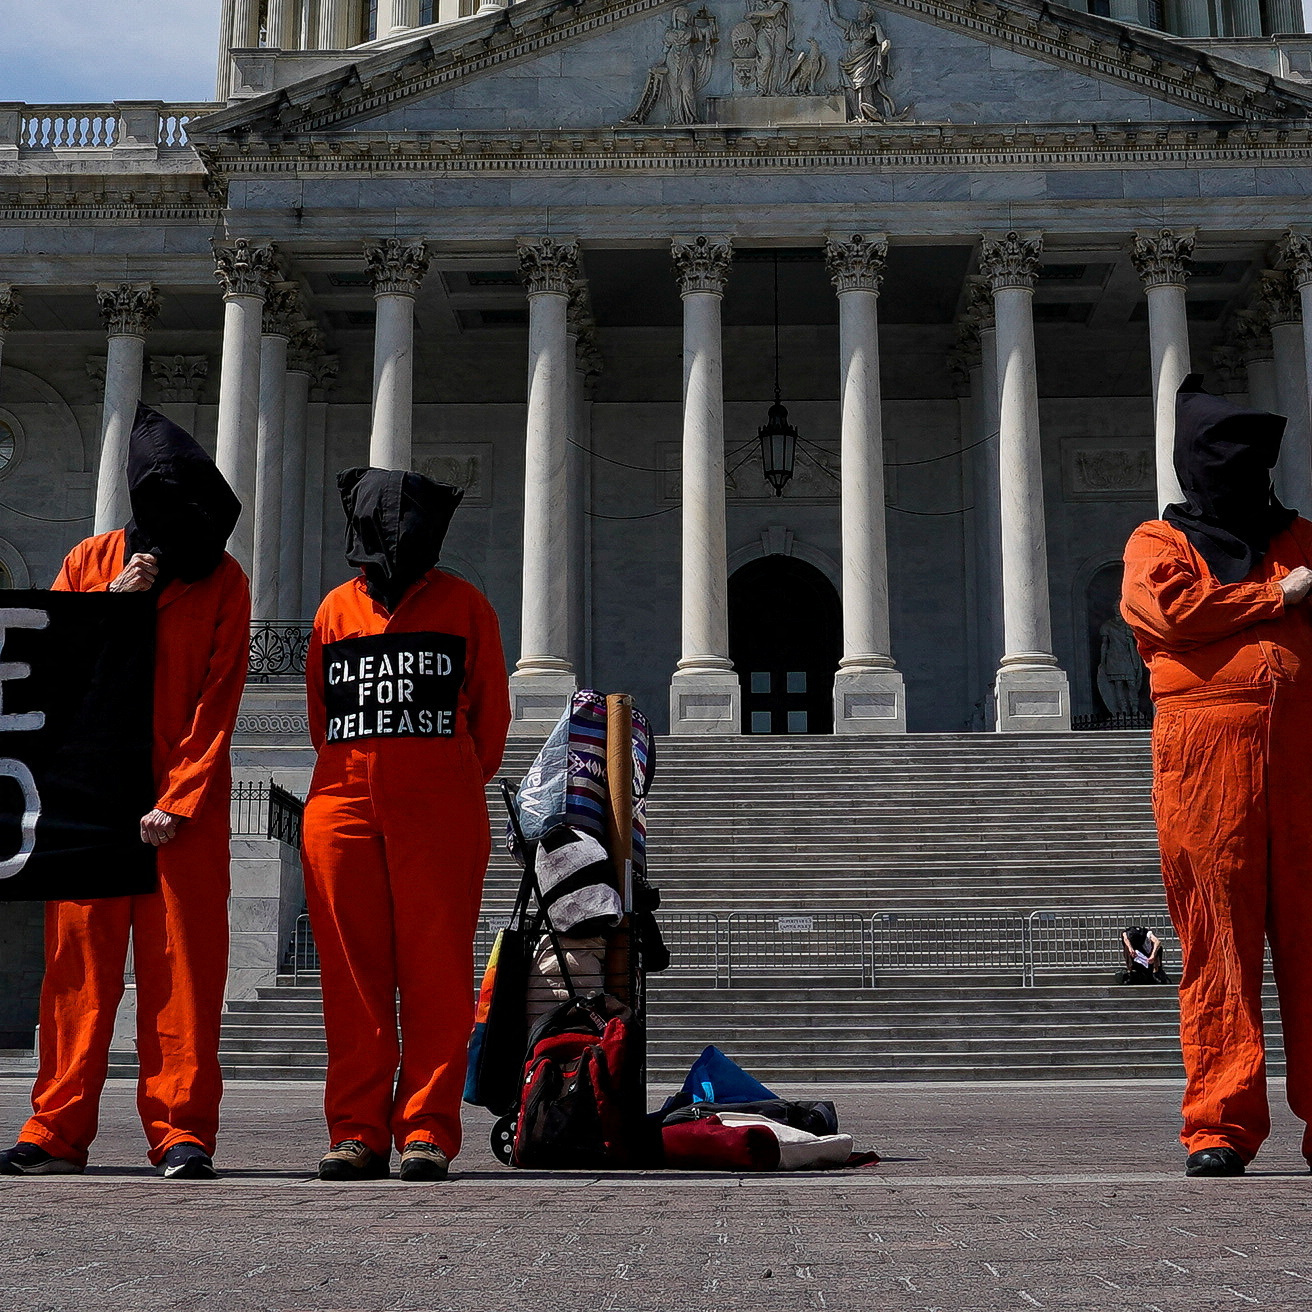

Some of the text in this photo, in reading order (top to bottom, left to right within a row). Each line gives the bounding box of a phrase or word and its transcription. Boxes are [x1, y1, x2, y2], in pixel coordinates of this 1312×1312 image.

[328, 651, 452, 686] CLEARED
[358, 679, 414, 706] FOR
[327, 710, 452, 741] RELEASE
